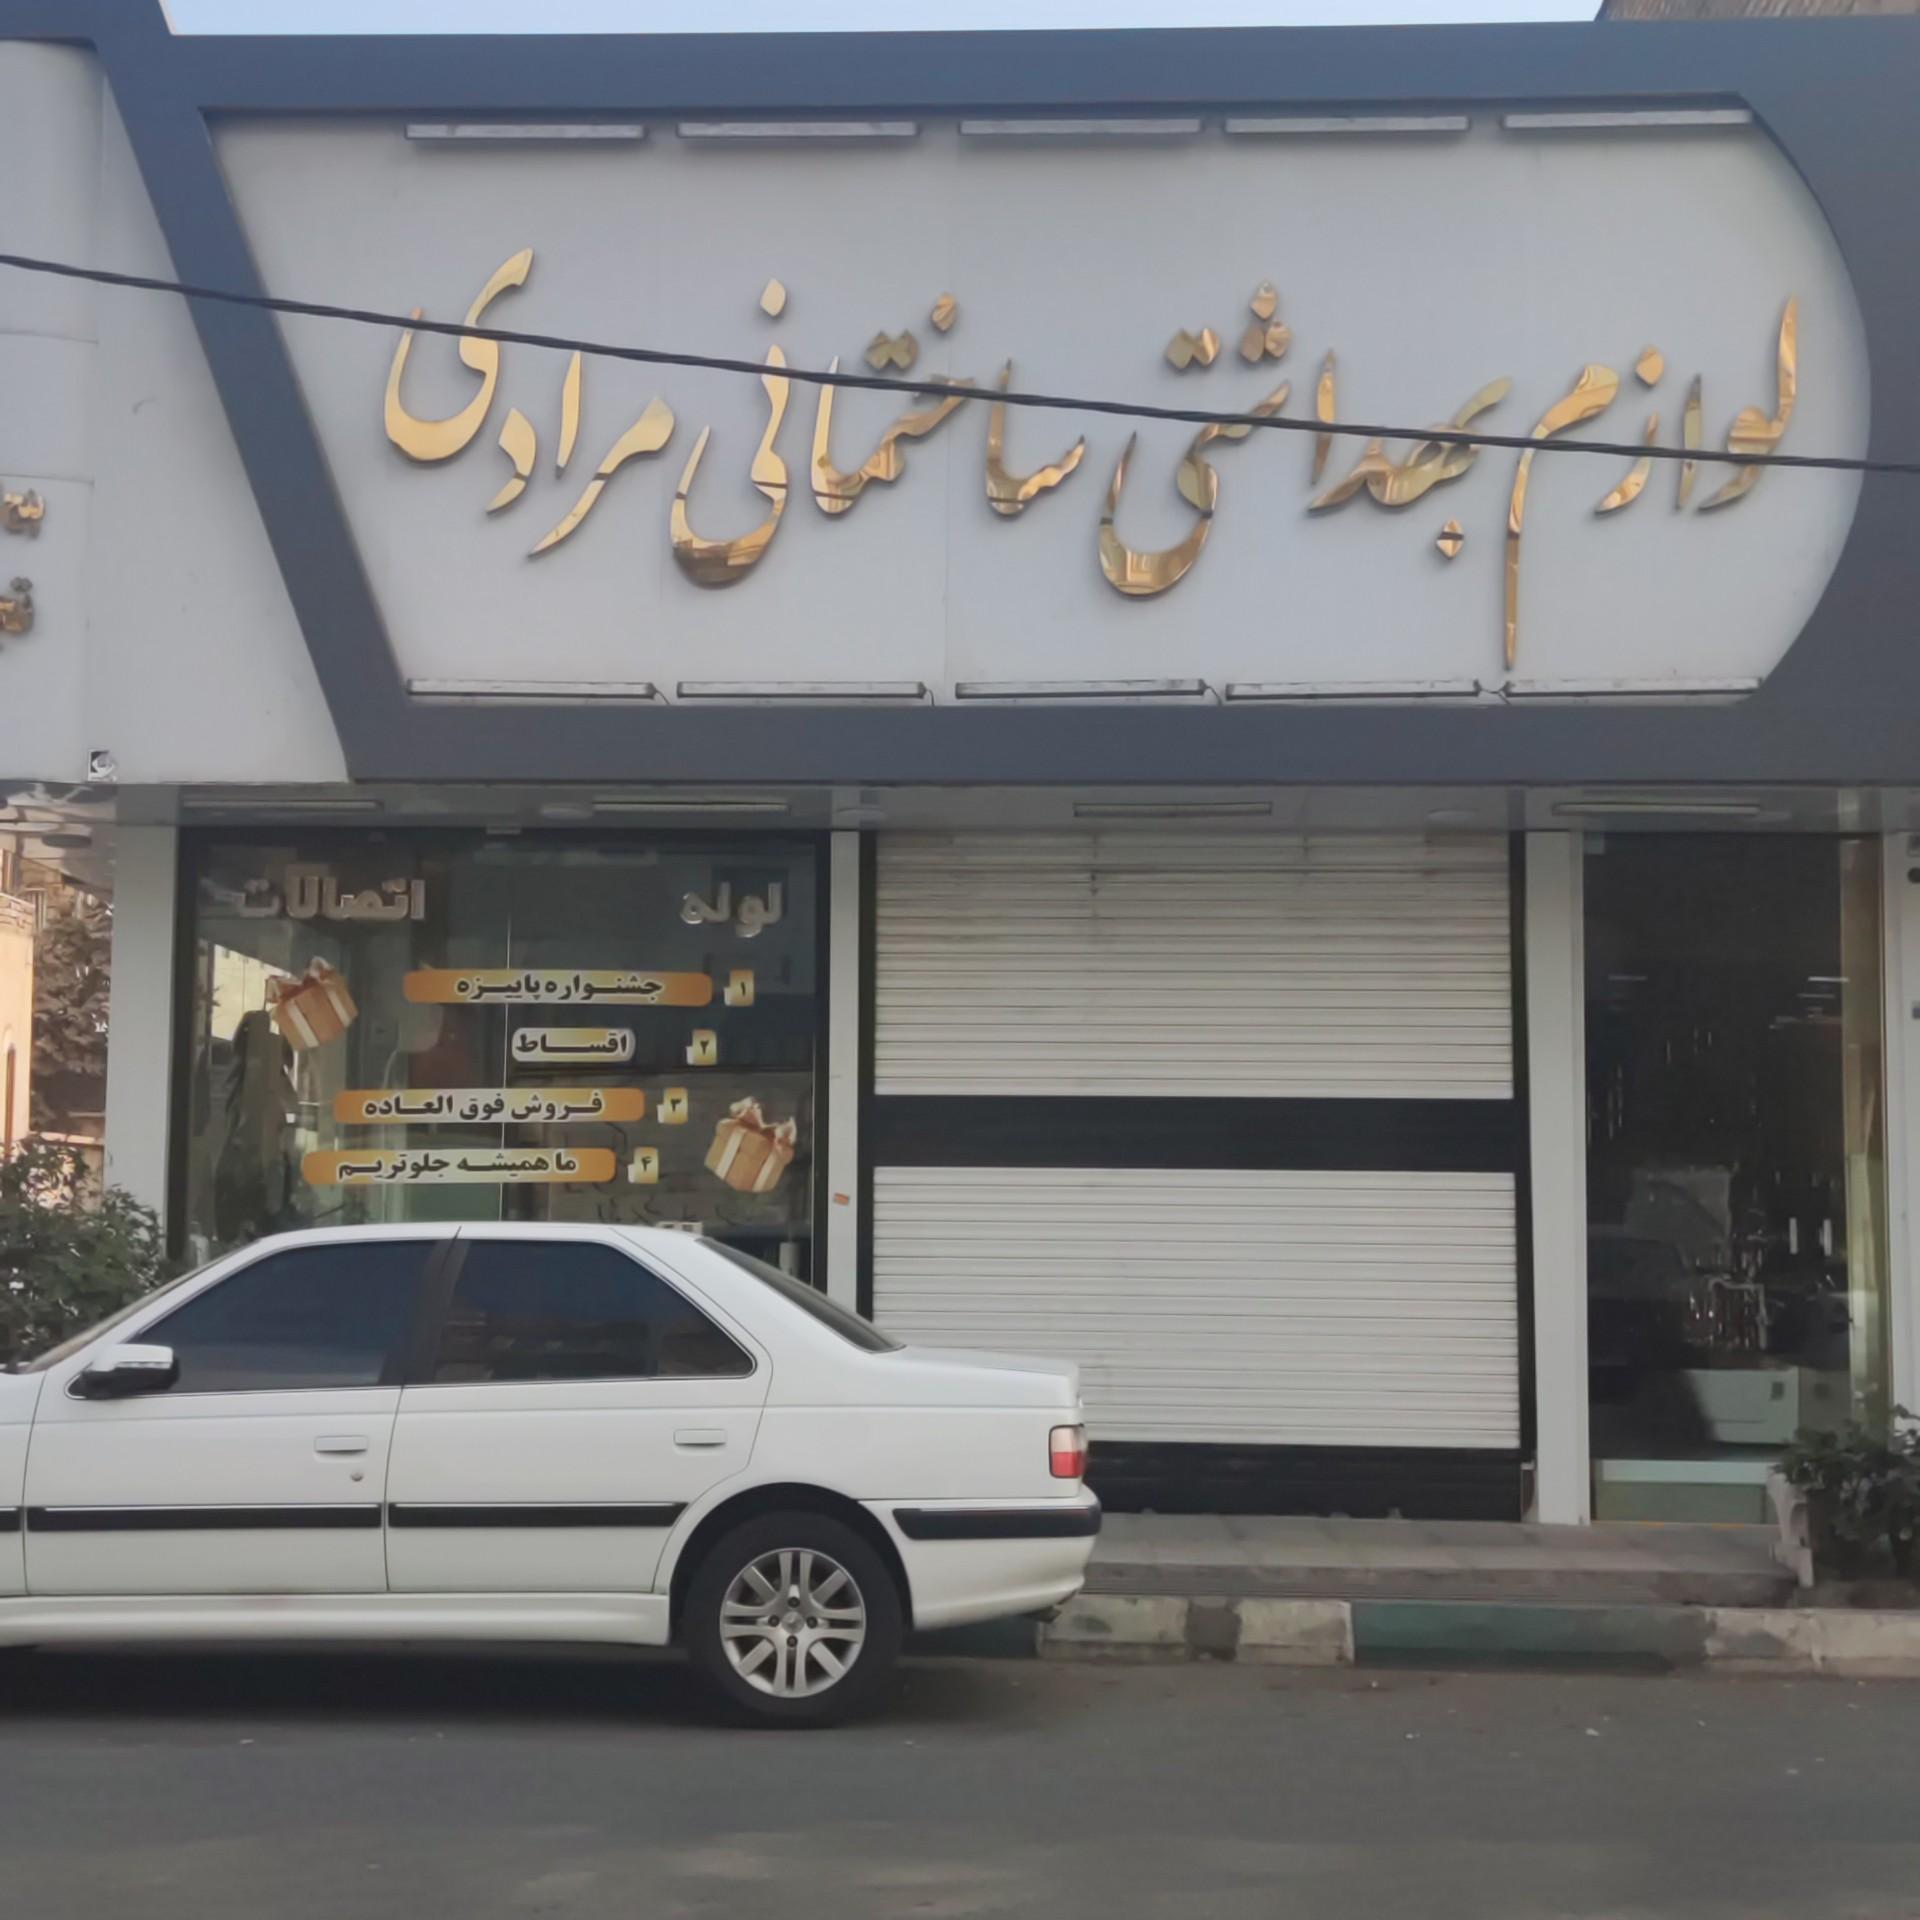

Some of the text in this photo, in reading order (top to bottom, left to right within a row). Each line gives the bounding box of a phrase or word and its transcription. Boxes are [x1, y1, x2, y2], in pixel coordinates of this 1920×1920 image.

[384, 248, 1797, 670] لوازم بهداشتی ساختمانی مرادی
[238, 876, 425, 920] اتصالات
[681, 881, 782, 938] لوله
[457, 973, 540, 1000] پاییزه
[545, 974, 663, 1001] جشنواره
[516, 1032, 628, 1053] اقساط
[364, 1095, 454, 1116] العاده
[459, 1093, 504, 1120] فوق
[511, 1091, 603, 1120] فروش
[338, 1152, 450, 1180] جلوتریم
[457, 1152, 549, 1177] همیشه
[556, 1152, 576, 1172] ما
